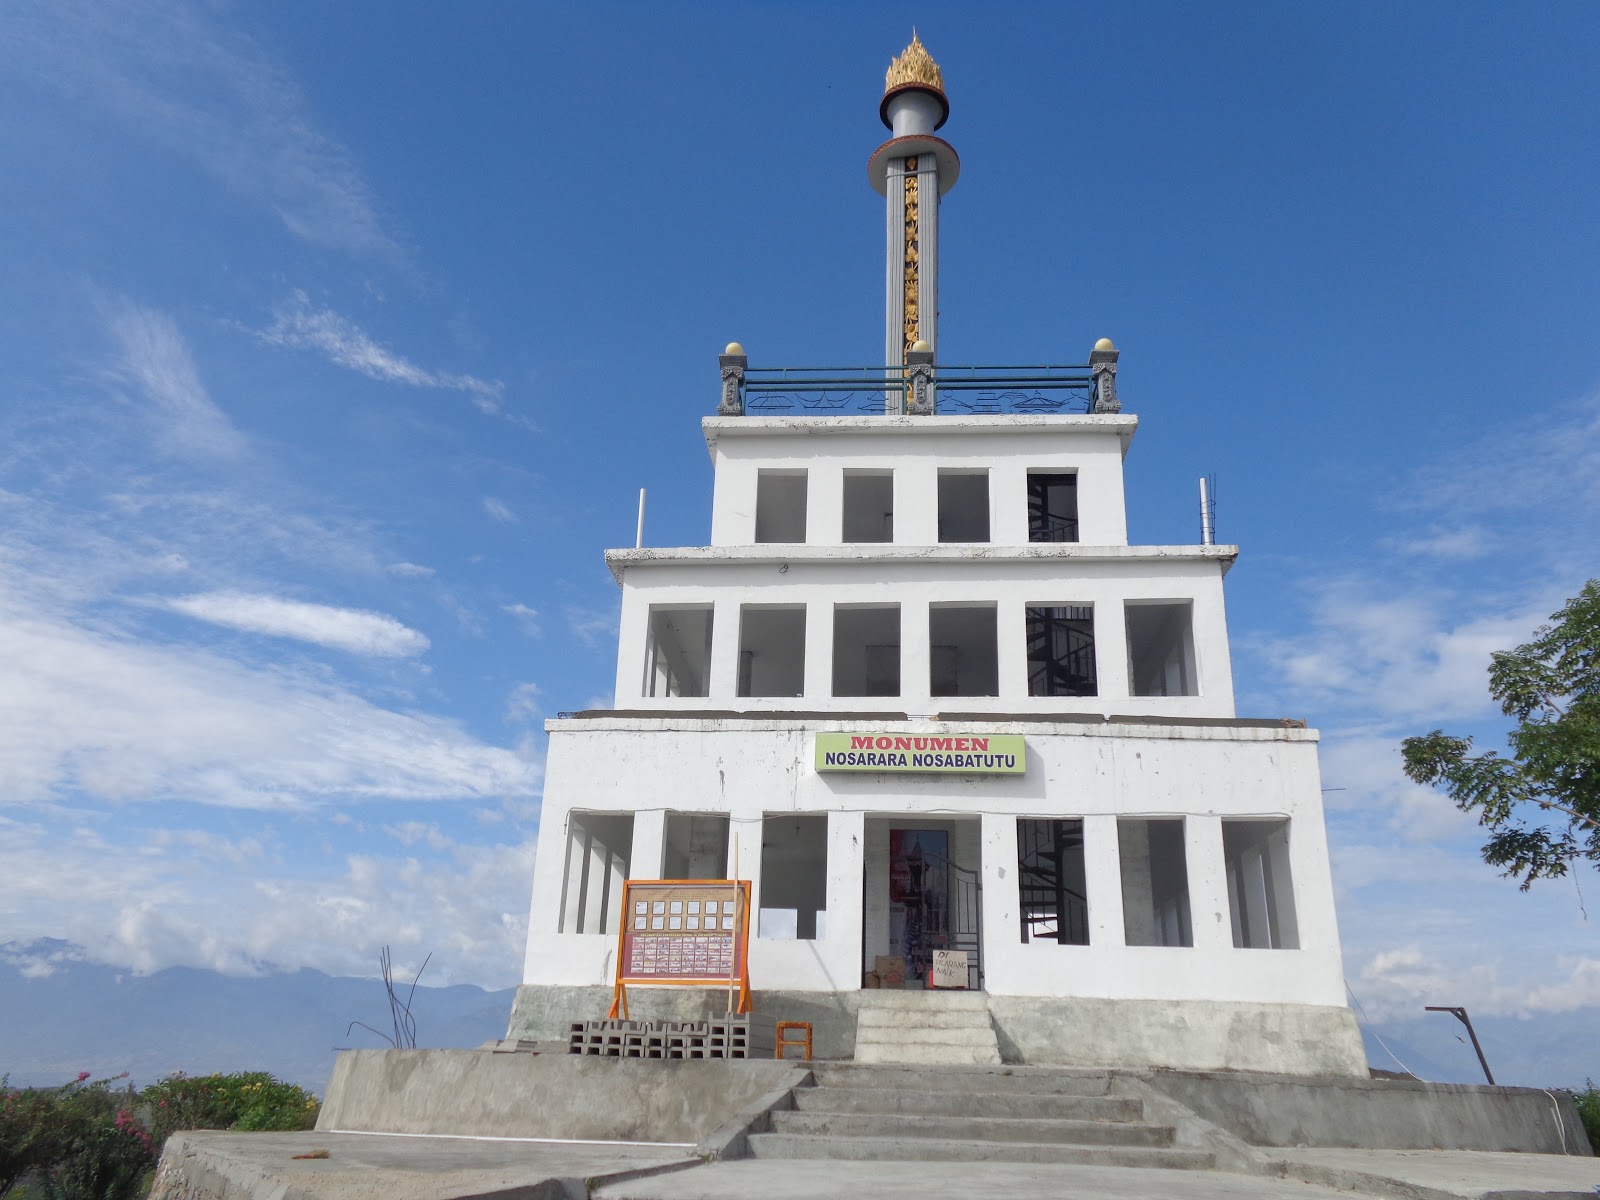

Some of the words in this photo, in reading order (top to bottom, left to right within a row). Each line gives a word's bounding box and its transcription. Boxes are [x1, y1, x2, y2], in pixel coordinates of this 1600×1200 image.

[850, 736, 989, 751] MONUMEN
[825, 752, 908, 767] NOSARARA
[912, 753, 1016, 768] NOSABATUTU
[938, 951, 949, 959] DI
[936, 967, 955, 978] NAIK
